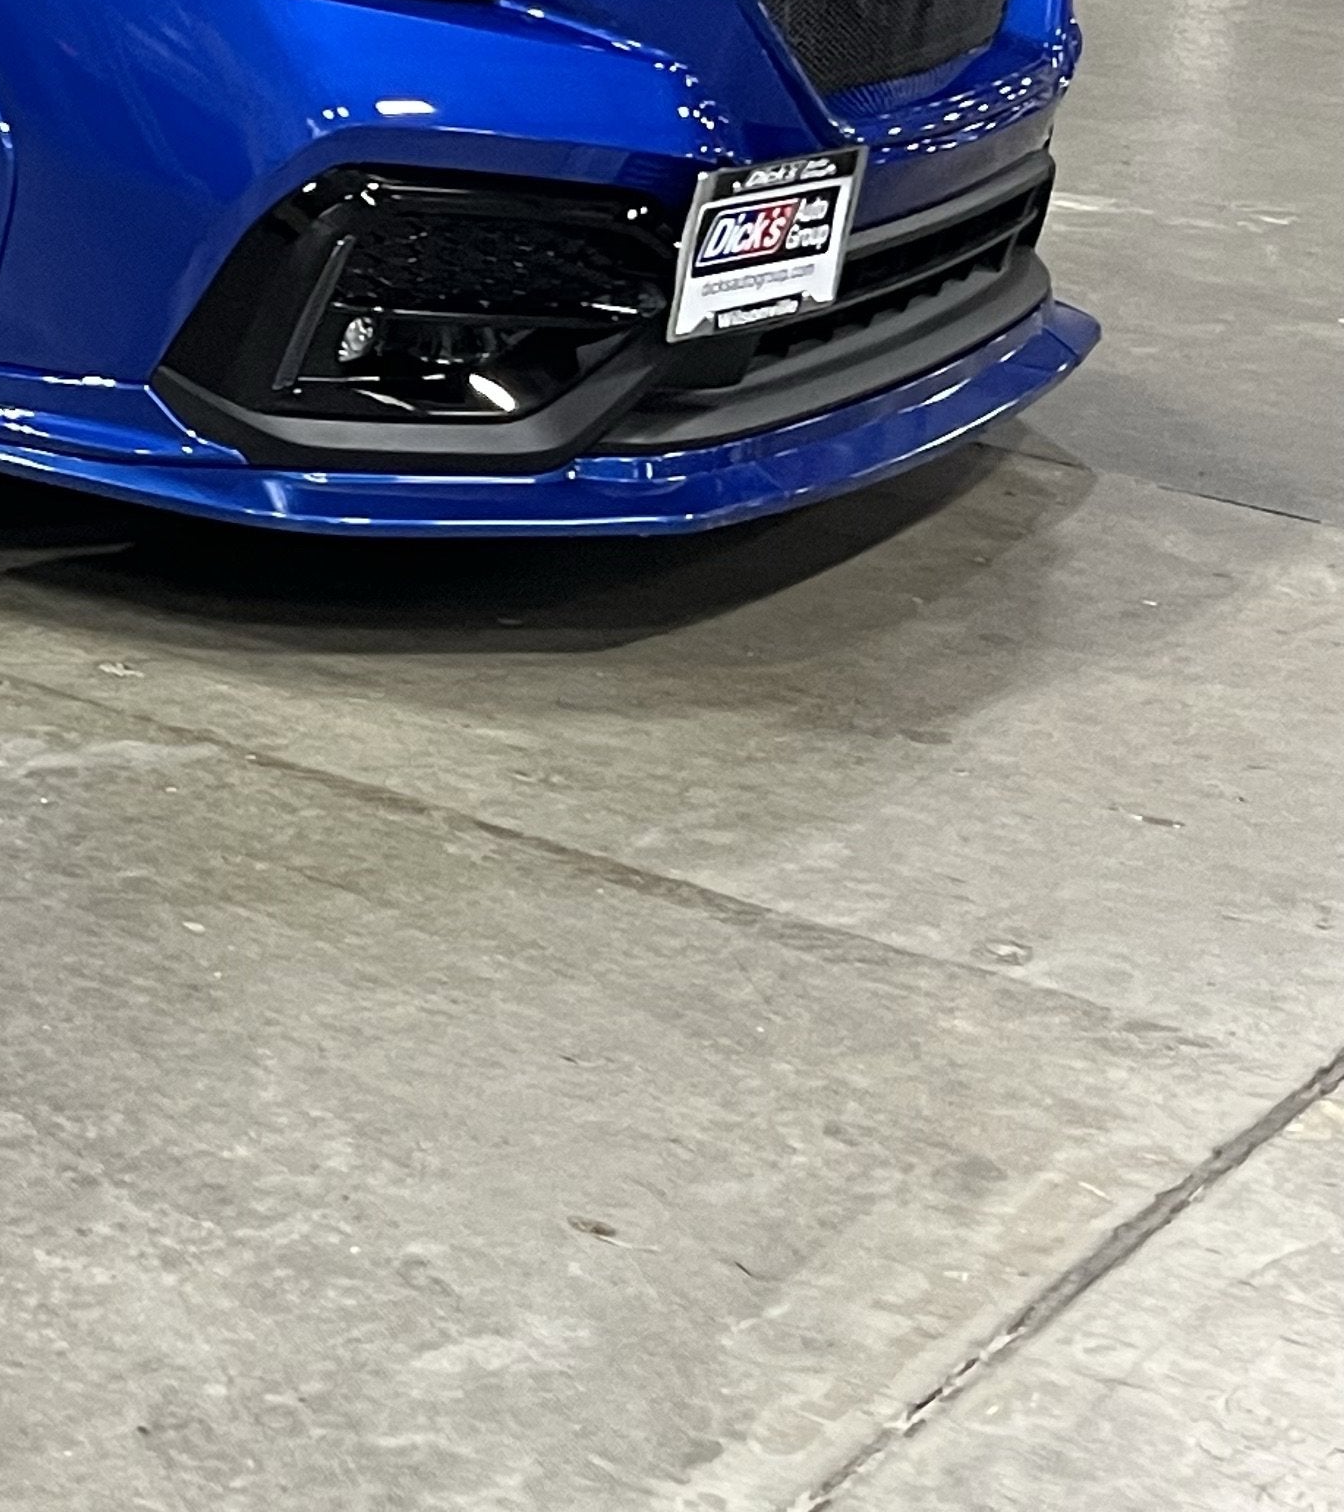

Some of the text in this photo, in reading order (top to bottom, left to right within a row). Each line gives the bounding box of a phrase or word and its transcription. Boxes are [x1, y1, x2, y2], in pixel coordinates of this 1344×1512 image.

[794, 196, 830, 223] Auto
[702, 206, 788, 259] Dick's
[784, 223, 831, 250] Group
